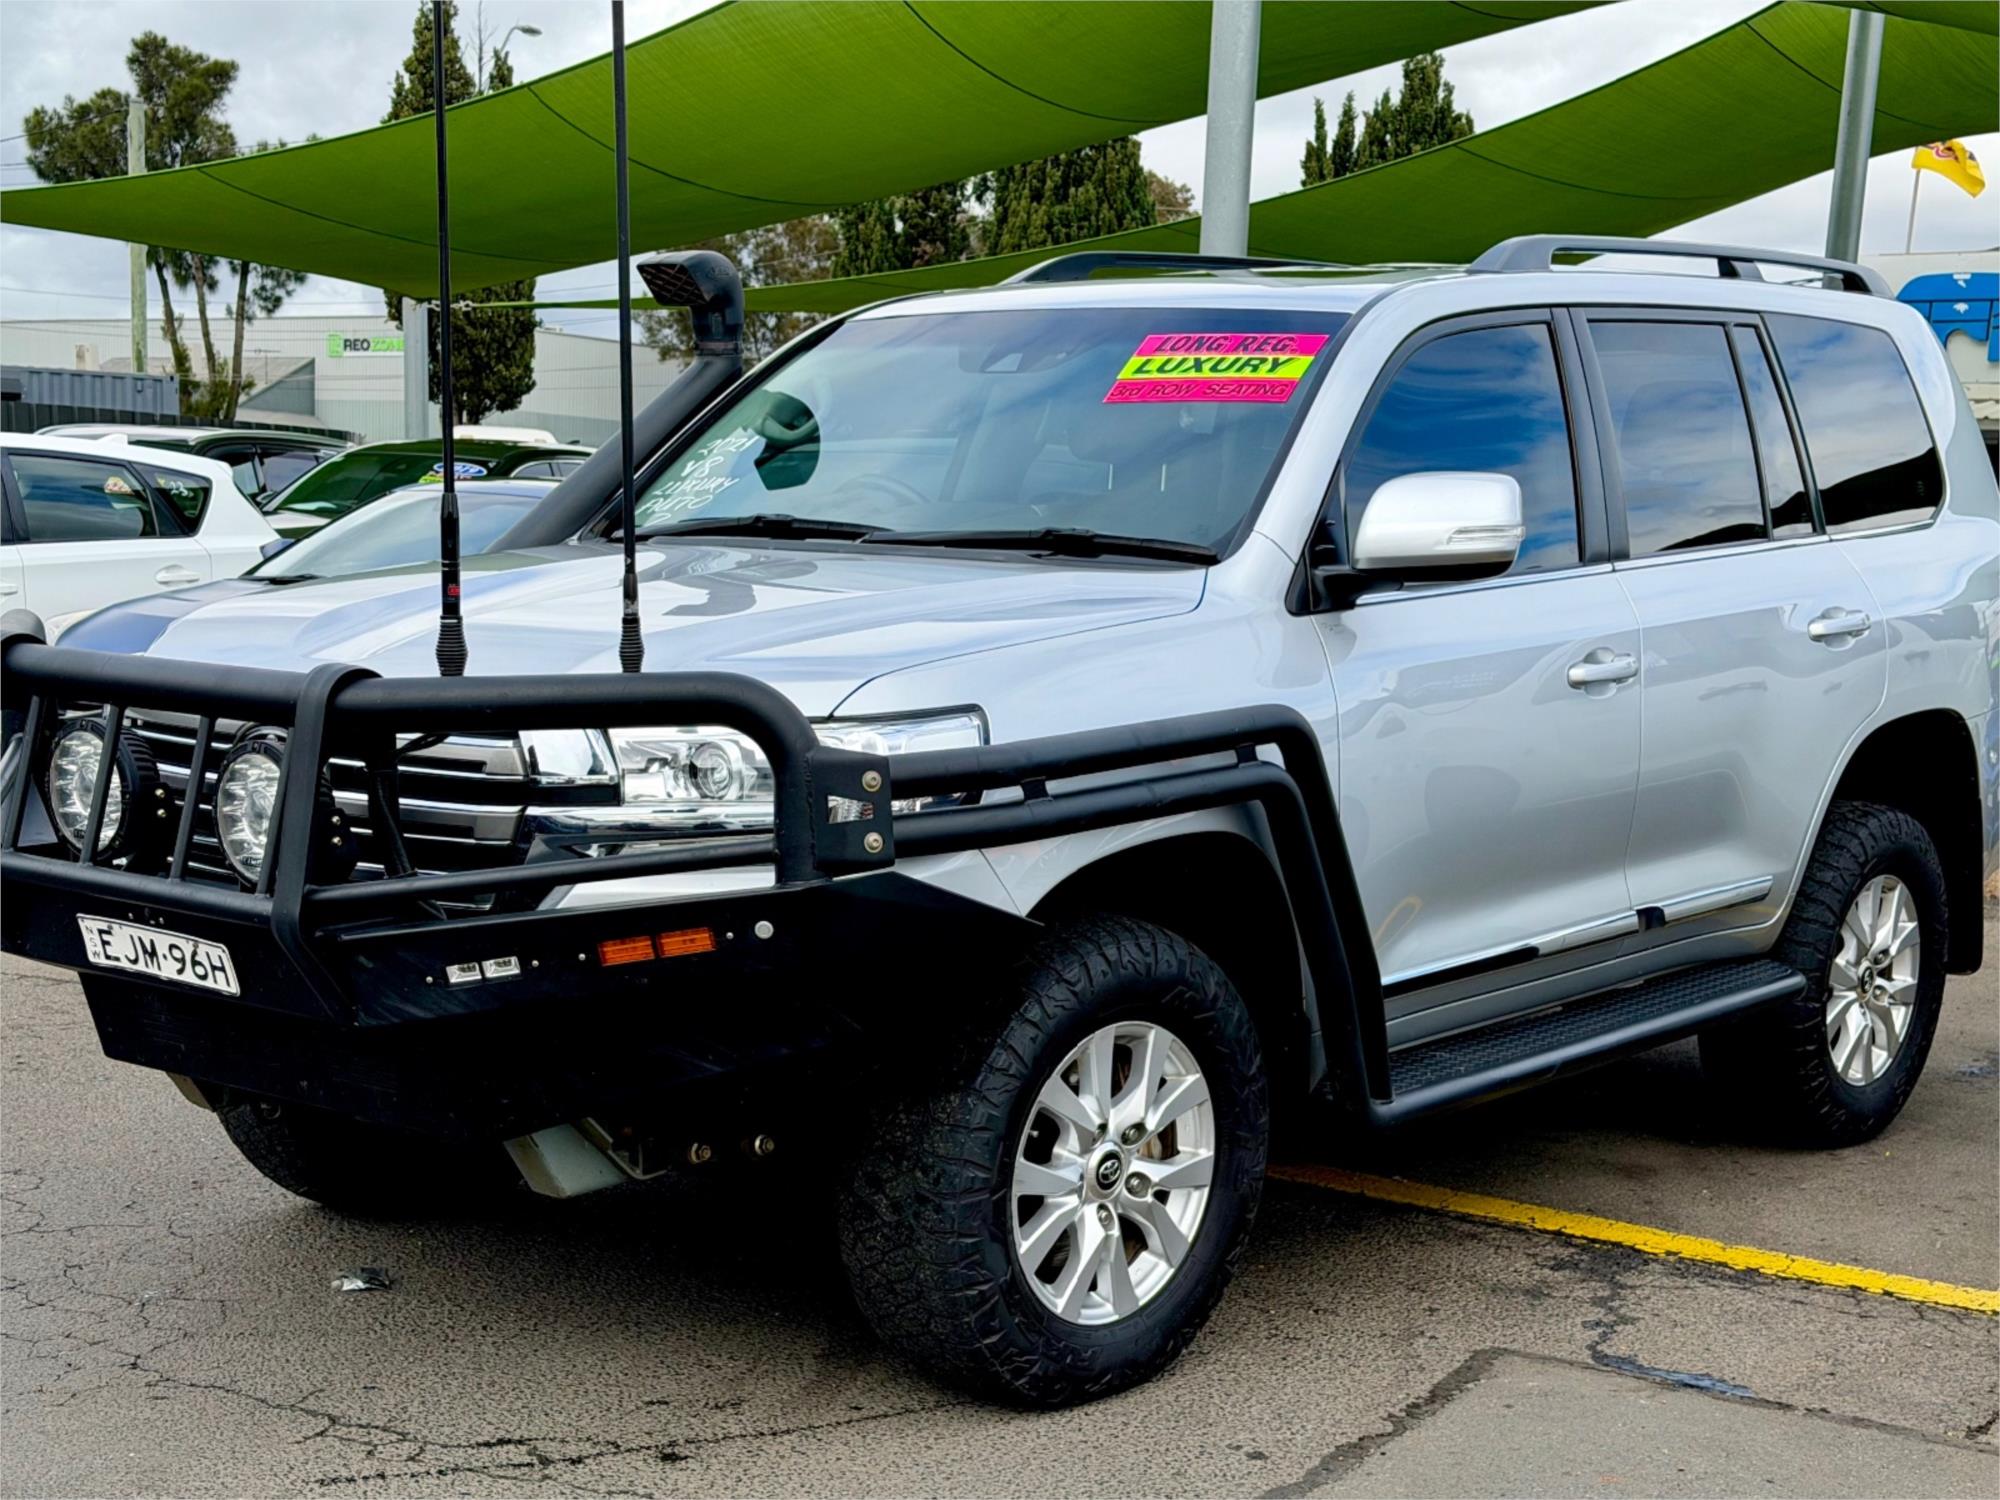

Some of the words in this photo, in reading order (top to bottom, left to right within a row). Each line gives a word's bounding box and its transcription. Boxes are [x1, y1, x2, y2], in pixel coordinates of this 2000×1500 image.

[1154, 335, 1231, 353] LONG
[1236, 335, 1299, 353] REG.
[1131, 356, 1299, 375] LUXURY
[1110, 383, 1143, 397] 3rd
[1149, 383, 1200, 397] ROW
[1201, 383, 1289, 396] SEATING
[681, 456, 724, 478] V8
